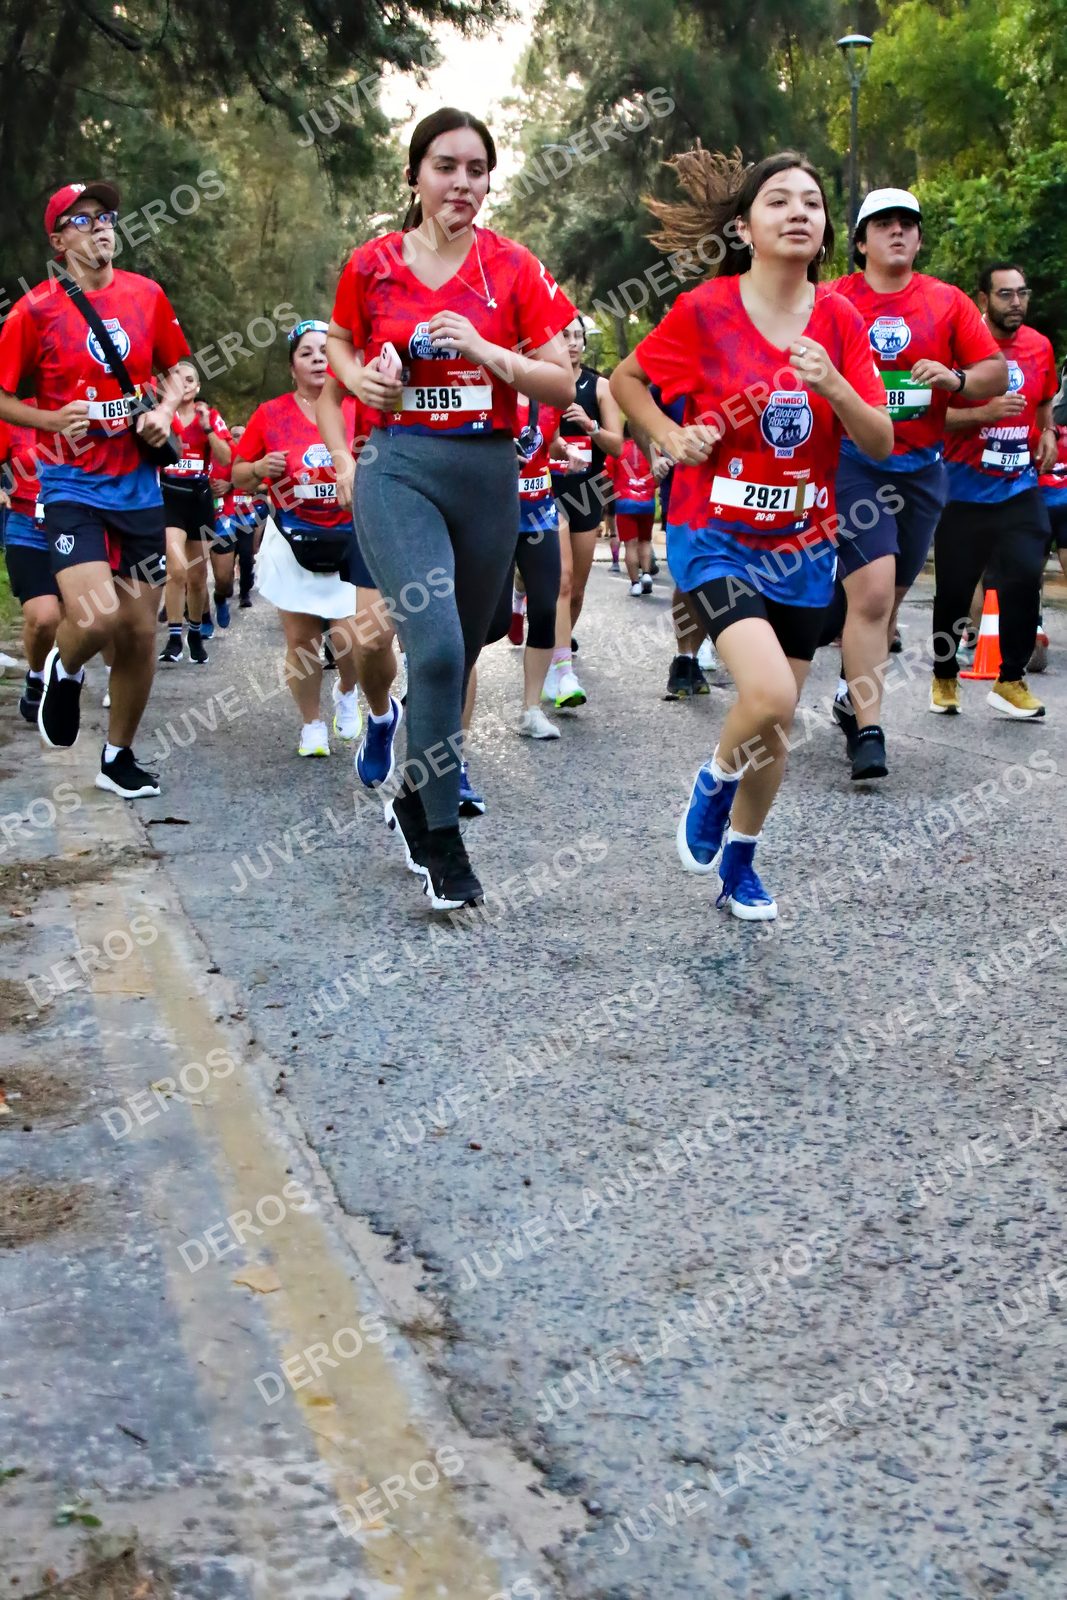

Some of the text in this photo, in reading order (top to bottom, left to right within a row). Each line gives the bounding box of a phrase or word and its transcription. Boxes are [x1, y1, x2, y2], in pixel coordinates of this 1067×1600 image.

[415, 388, 462, 409] 3595
[775, 397, 802, 405] BIMBO
[886, 391, 905, 406] 88
[102, 401, 131, 418] 1699
[774, 408, 802, 419] Global
[769, 417, 790, 427] Race
[776, 449, 792, 457] 2026
[1001, 454, 1020, 466] 5712
[314, 484, 337, 498] 192
[743, 485, 791, 509] 2921
[754, 512, 776, 522] 20-26
